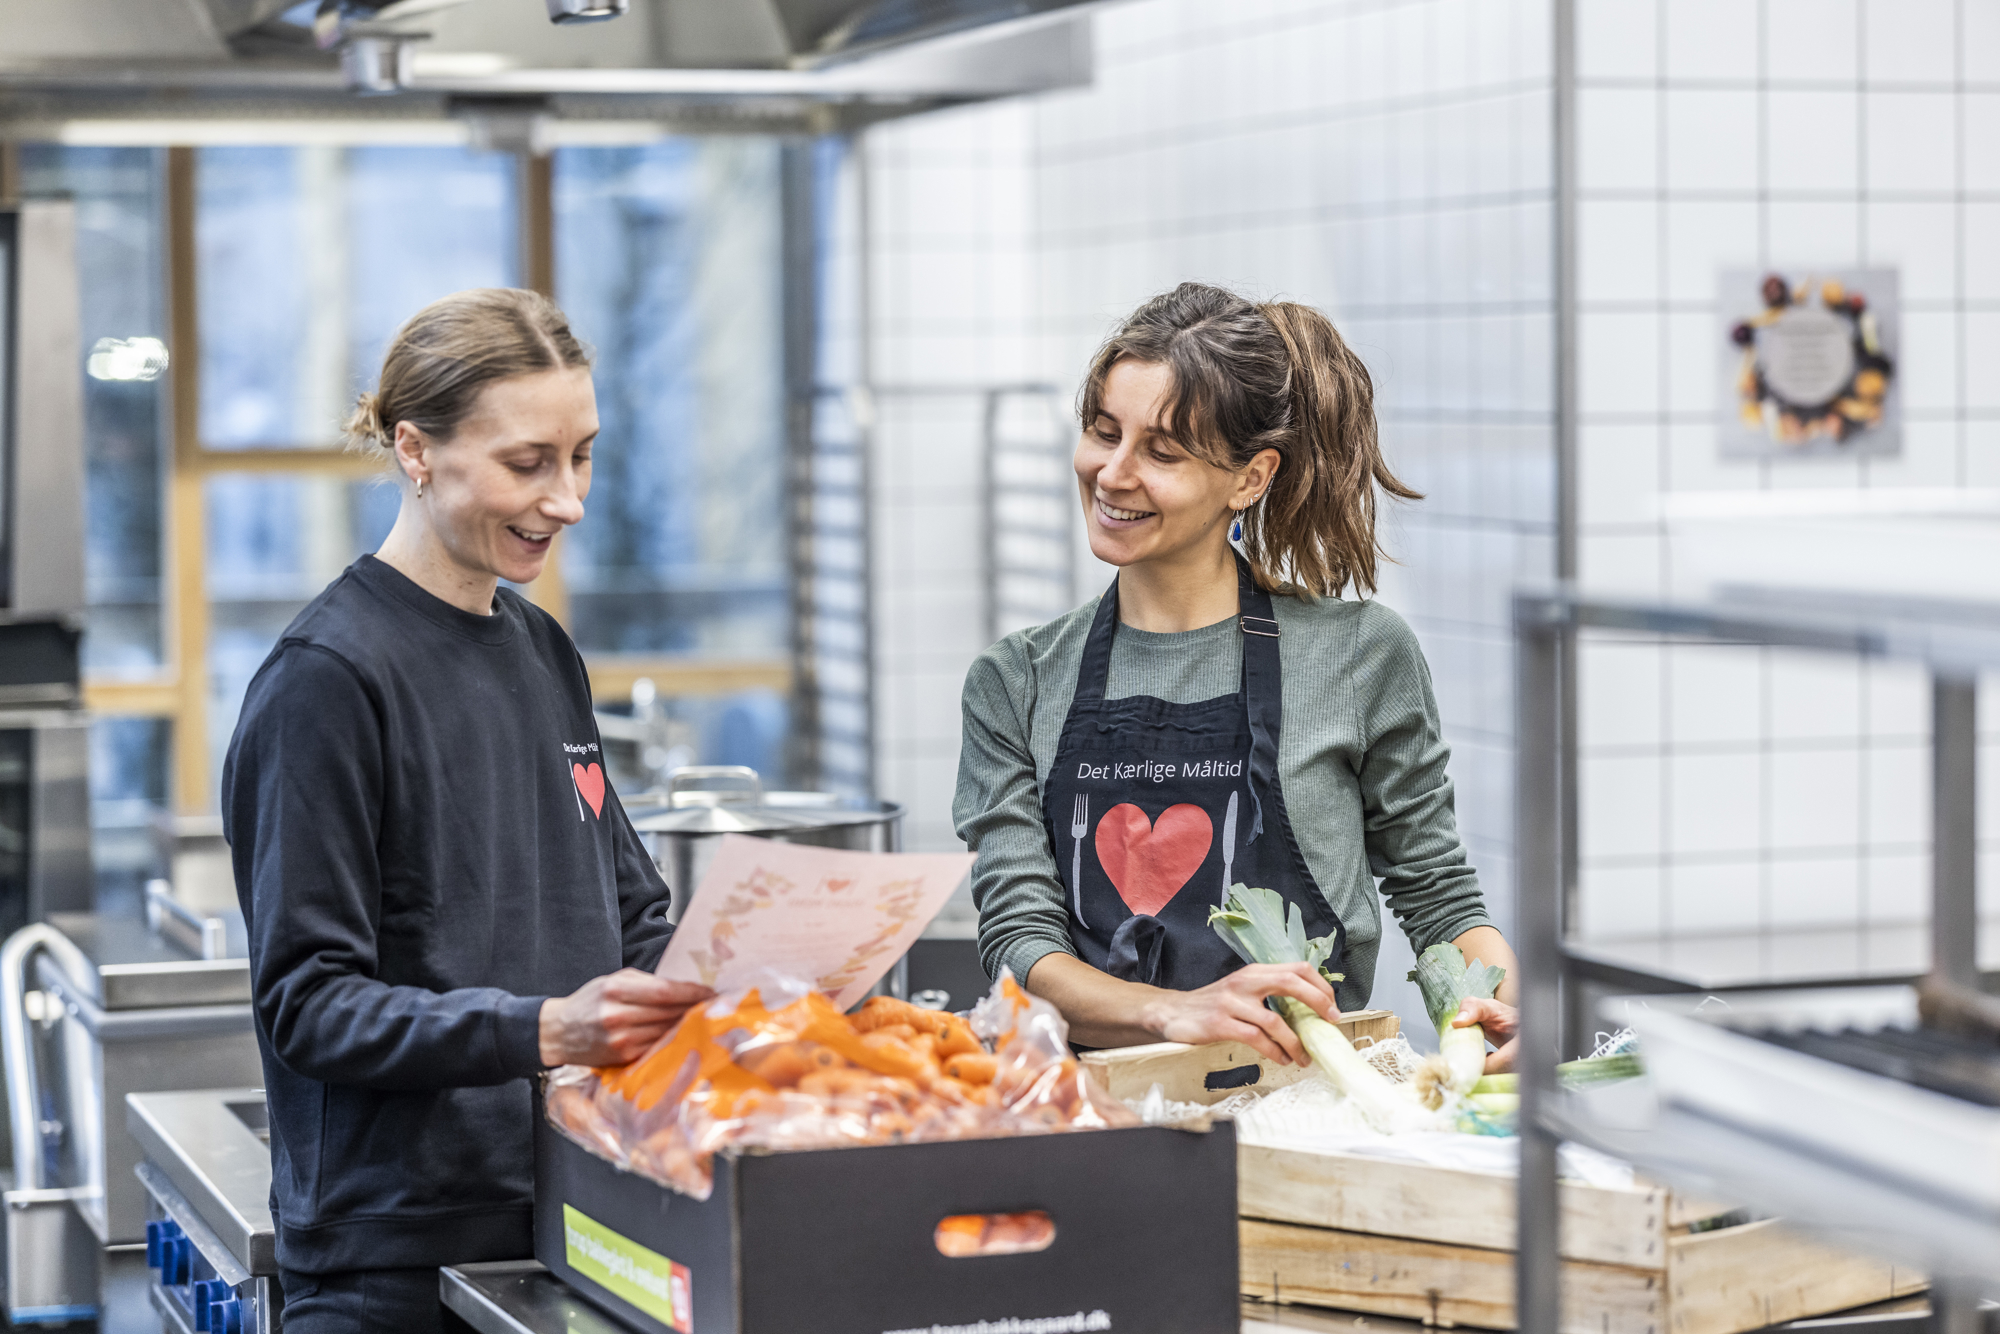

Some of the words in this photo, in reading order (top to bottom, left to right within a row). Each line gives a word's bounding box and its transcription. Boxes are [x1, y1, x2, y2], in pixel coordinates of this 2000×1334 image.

[1077, 762, 1111, 780] Det
[1114, 760, 1176, 783] Kærlige
[1182, 760, 1242, 777] Måltid
